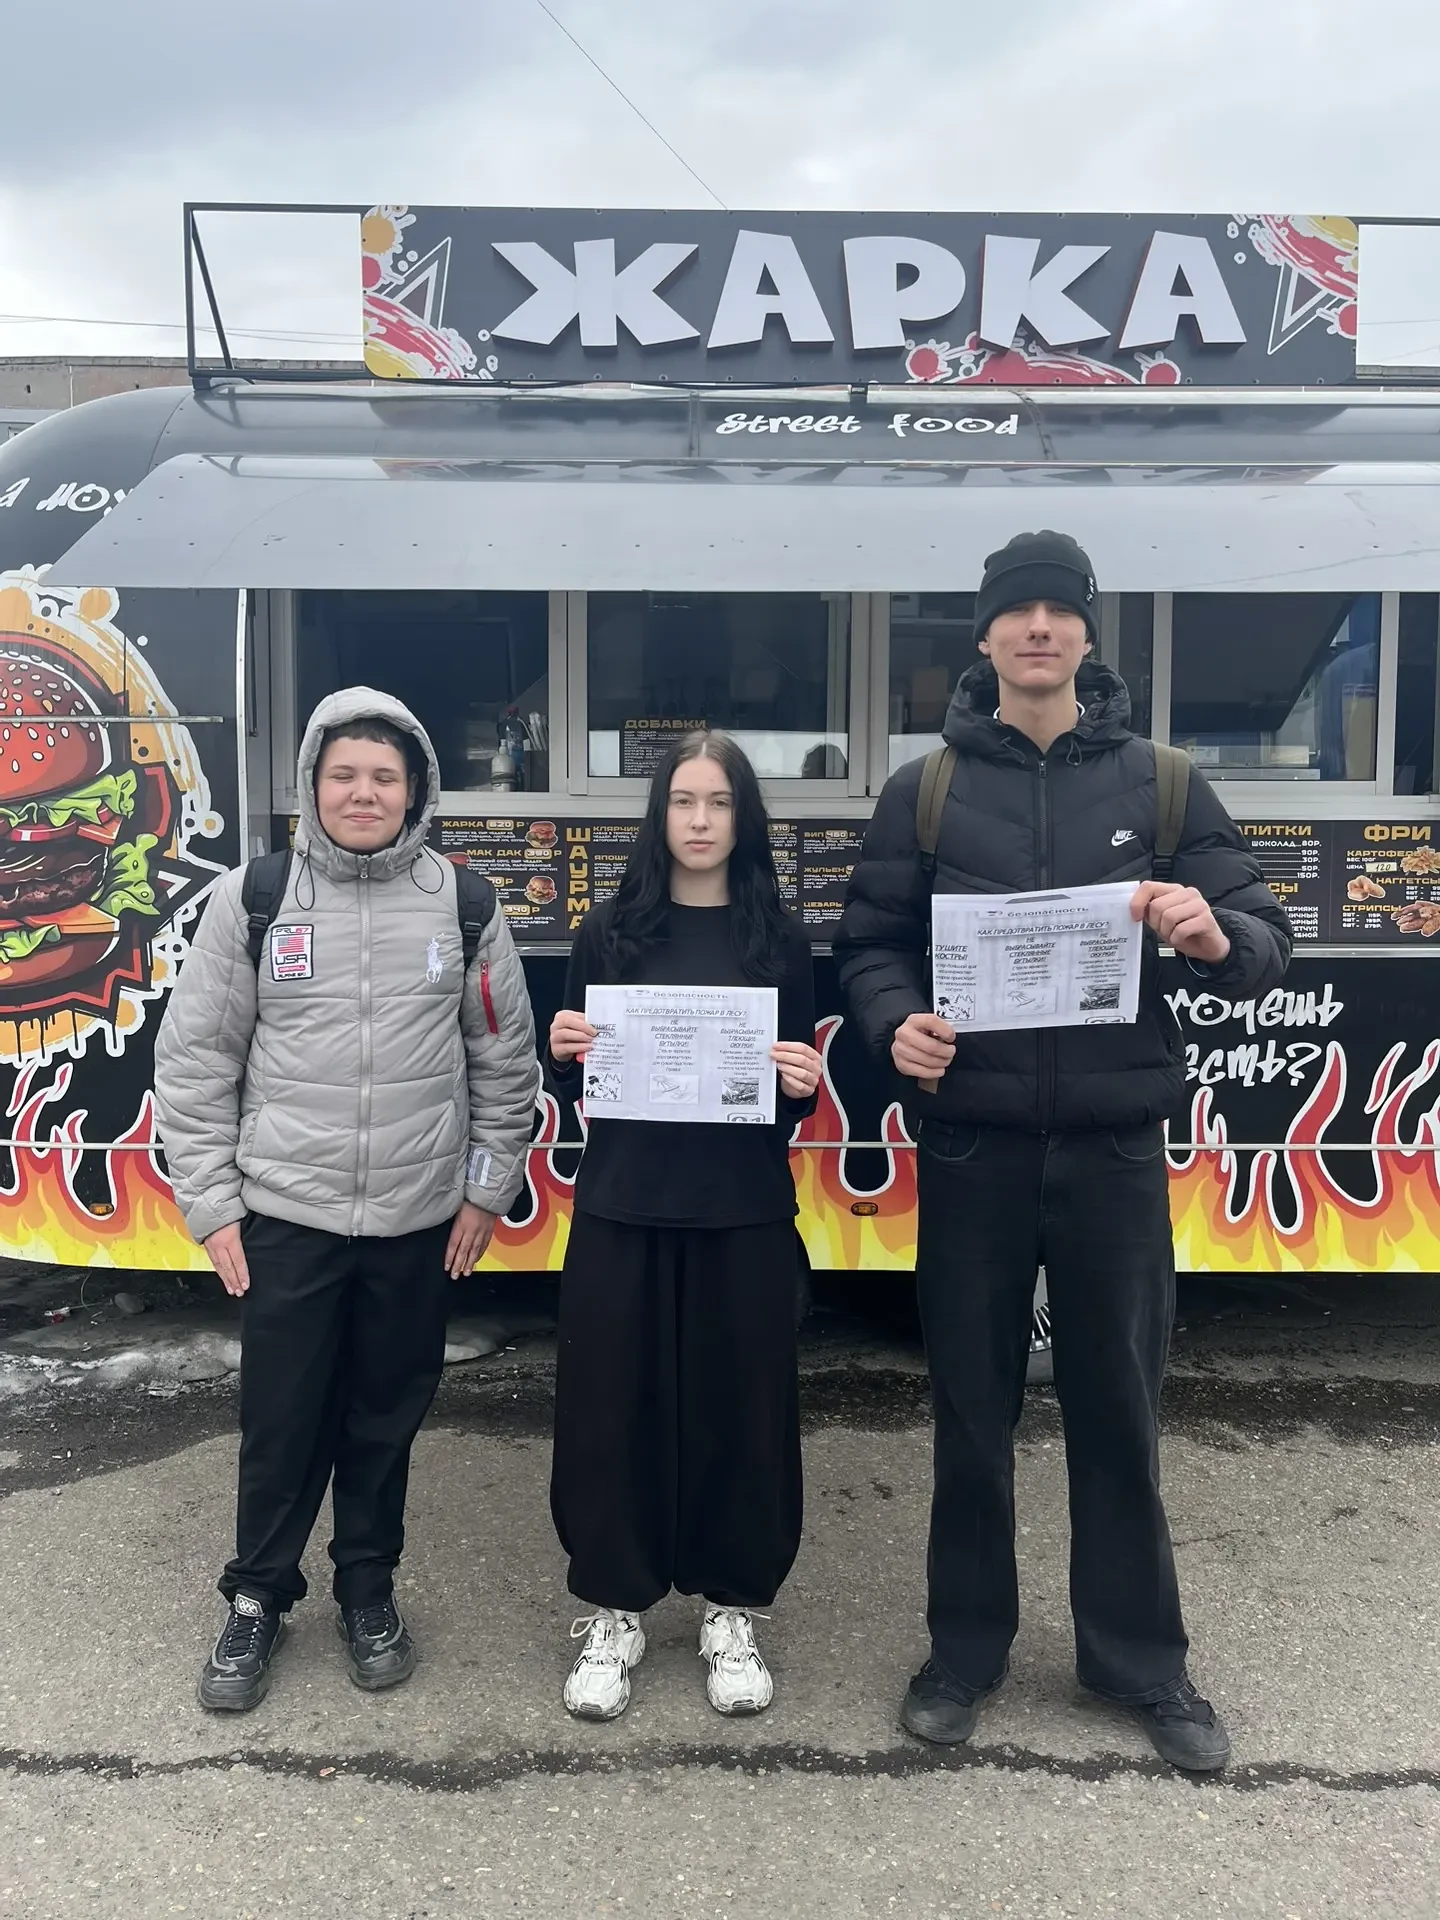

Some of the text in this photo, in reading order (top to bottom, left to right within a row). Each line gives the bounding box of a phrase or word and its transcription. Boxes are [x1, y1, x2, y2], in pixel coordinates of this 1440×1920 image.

[491, 229, 1247, 351] ЖАРКА
[716, 413, 1018, 437] Street food
[625, 720, 706, 729] ДОБАВКИ
[1237, 825, 1312, 835] ПИТКИ
[1364, 824, 1431, 841] ФРИ
[1114, 830, 1134, 840] NIKE
[1376, 864, 1391, 872] 120
[566, 828, 591, 930] ШАУРМА
[1268, 883, 1299, 892] СЫ
[1008, 908, 1089, 917] безопасность
[994, 925, 1052, 935] ПРЕДОТВРАТИТЬ
[1085, 921, 1109, 929] ЛЕСУ?
[1005, 942, 1055, 951] ВЫБРАСЫВАЙТЕ
[1080, 938, 1128, 946] ВЫБРАСЫВАЙТЕ
[935, 944, 967, 952] ТУШИТЕ
[1009, 950, 1051, 958] СТЕКЛЯННЫЕ
[275, 954, 308, 965] USA
[641, 1008, 694, 1016] ПРЕДОТВРАТИТЬ
